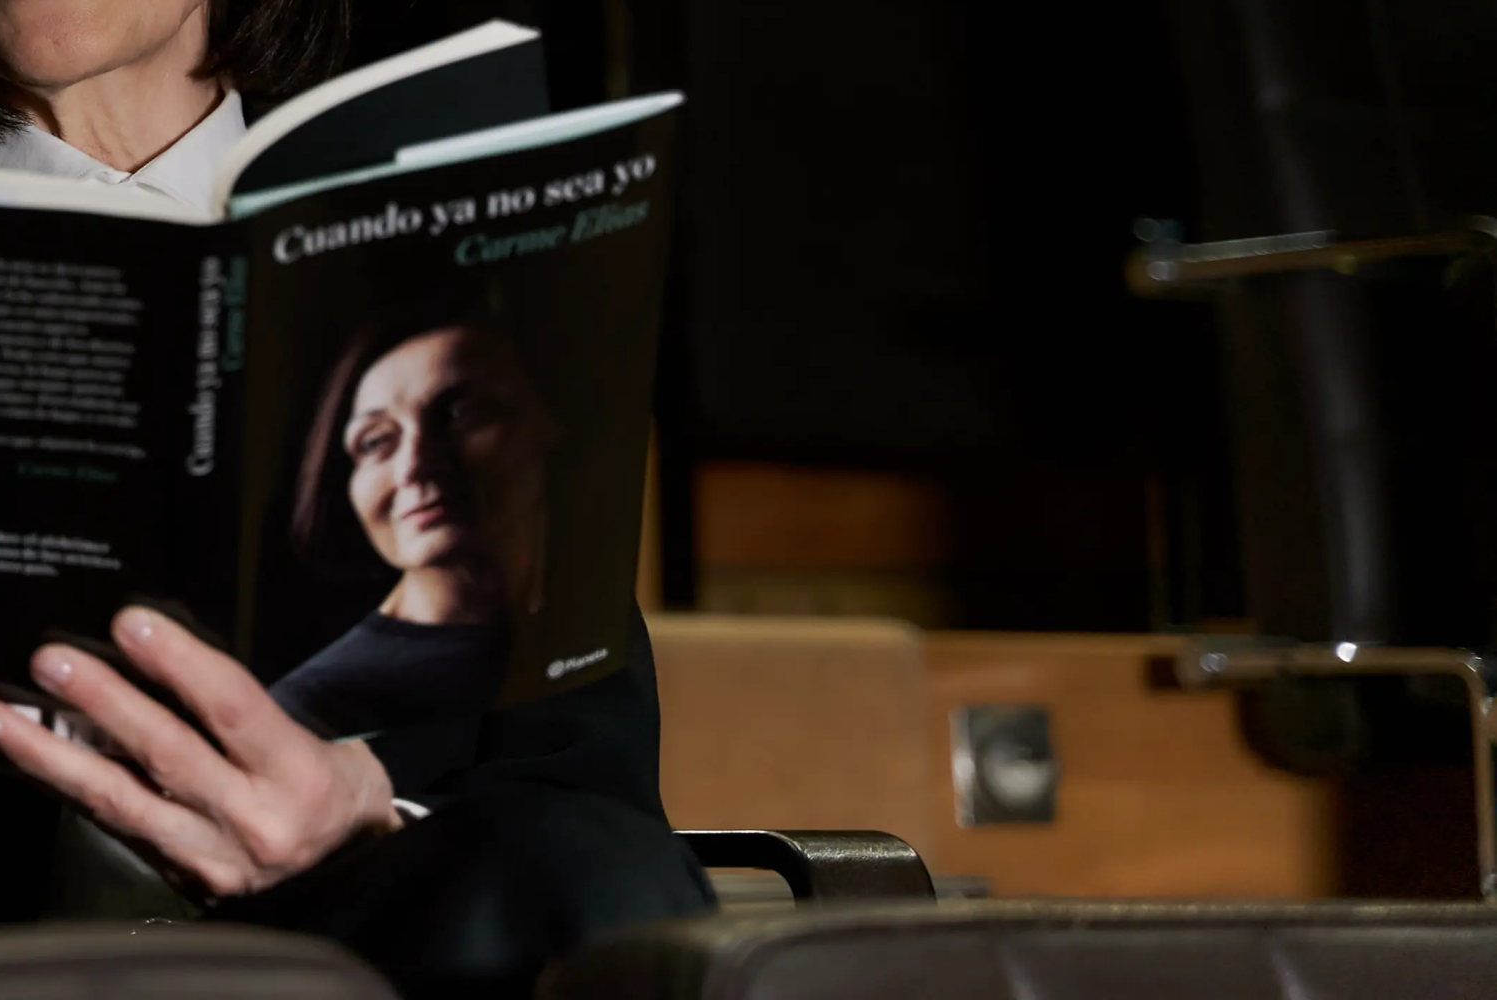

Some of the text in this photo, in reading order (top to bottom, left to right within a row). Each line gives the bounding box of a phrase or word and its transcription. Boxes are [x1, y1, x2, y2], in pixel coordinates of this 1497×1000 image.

[272, 153, 657, 265] Cuando ya no sea yo
[454, 223, 568, 267] Carme
